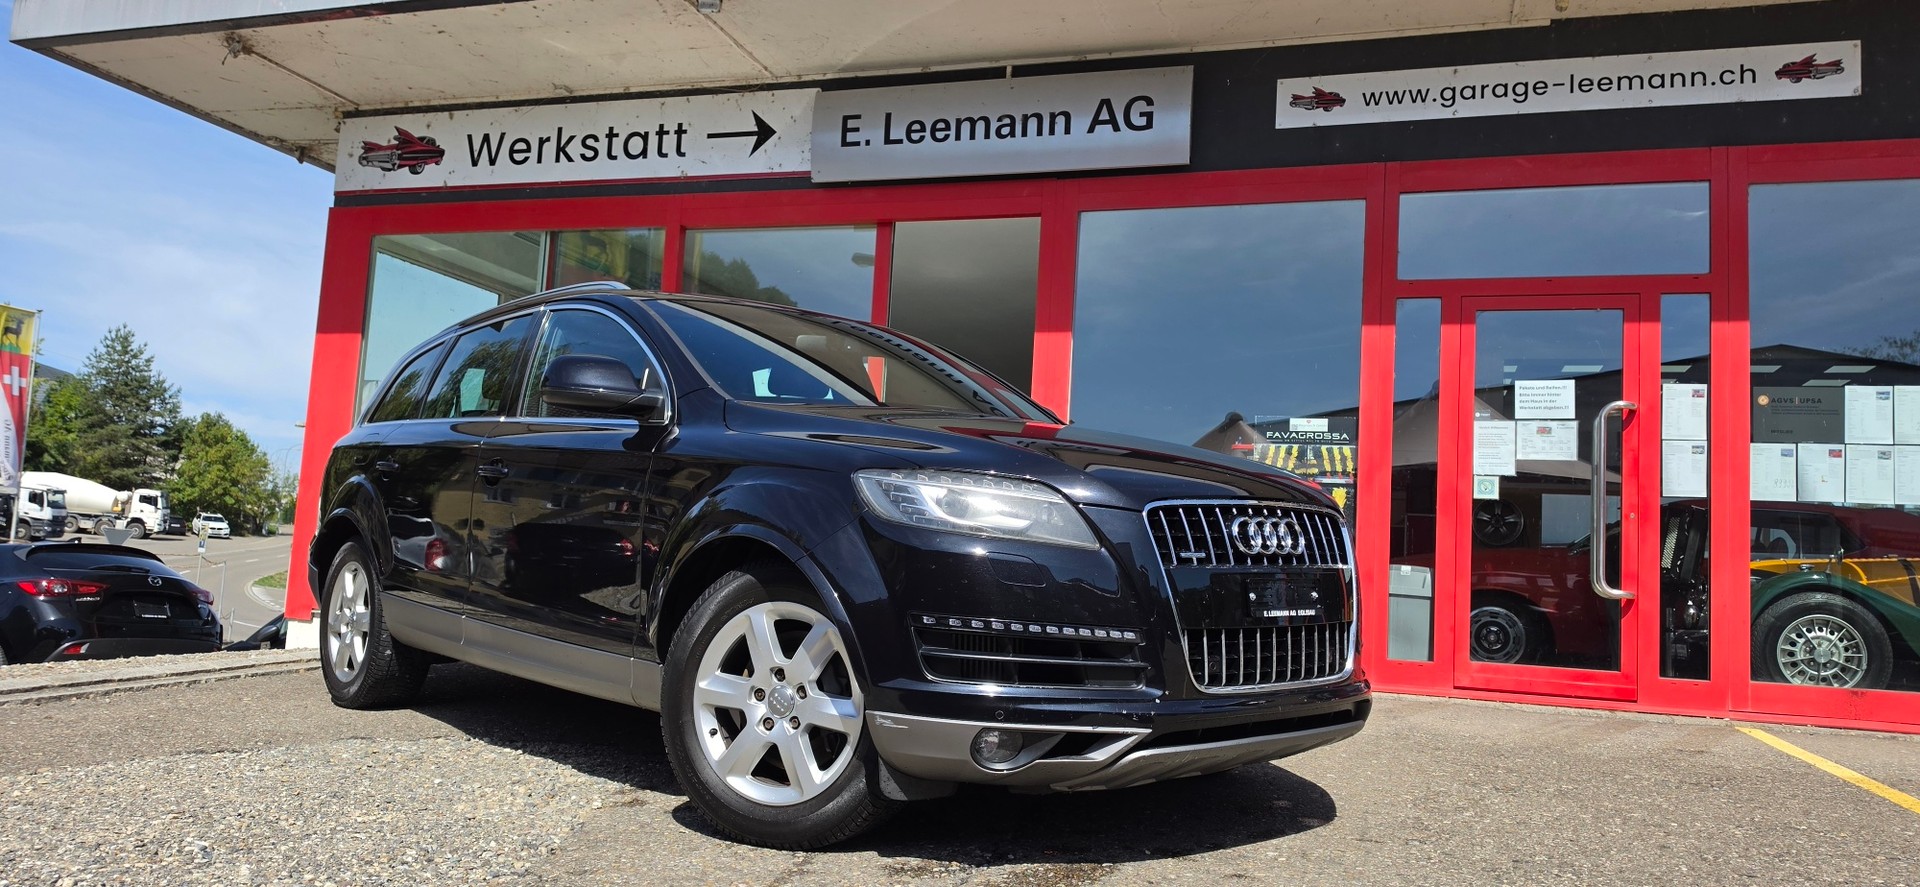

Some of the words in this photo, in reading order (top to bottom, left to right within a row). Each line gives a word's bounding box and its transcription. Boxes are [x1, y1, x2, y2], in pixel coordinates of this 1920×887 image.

[1361, 63, 1757, 109] www.garage-leemann.ch
[840, 114, 871, 148] E.
[883, 110, 1072, 146] Leemann
[1086, 95, 1156, 134] AG
[466, 122, 688, 168] Werkstatt
[1266, 431, 1350, 439] FAVAGROSSA
